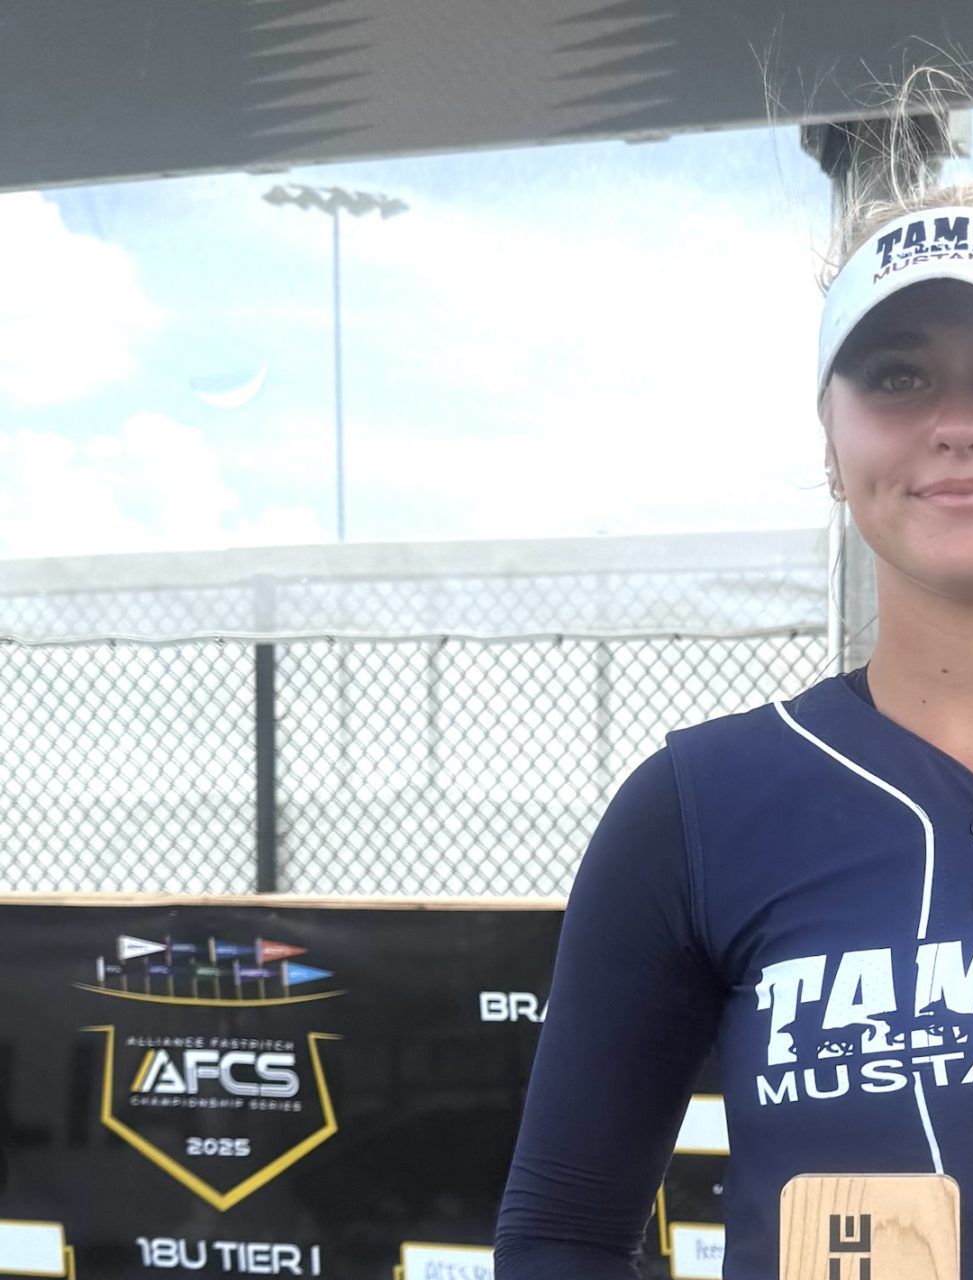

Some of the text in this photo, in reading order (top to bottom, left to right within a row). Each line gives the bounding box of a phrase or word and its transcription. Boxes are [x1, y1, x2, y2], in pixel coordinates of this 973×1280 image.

[480, 991, 549, 1023] BR
[126, 1035, 295, 1051] ALLIANCE FASTPITCH
[130, 1048, 300, 1098] AFCS
[129, 1095, 302, 1112] CHAMPIONSHIP SERIES
[186, 1136, 251, 1157] 2025
[136, 1236, 321, 1276] 18U TIER I
